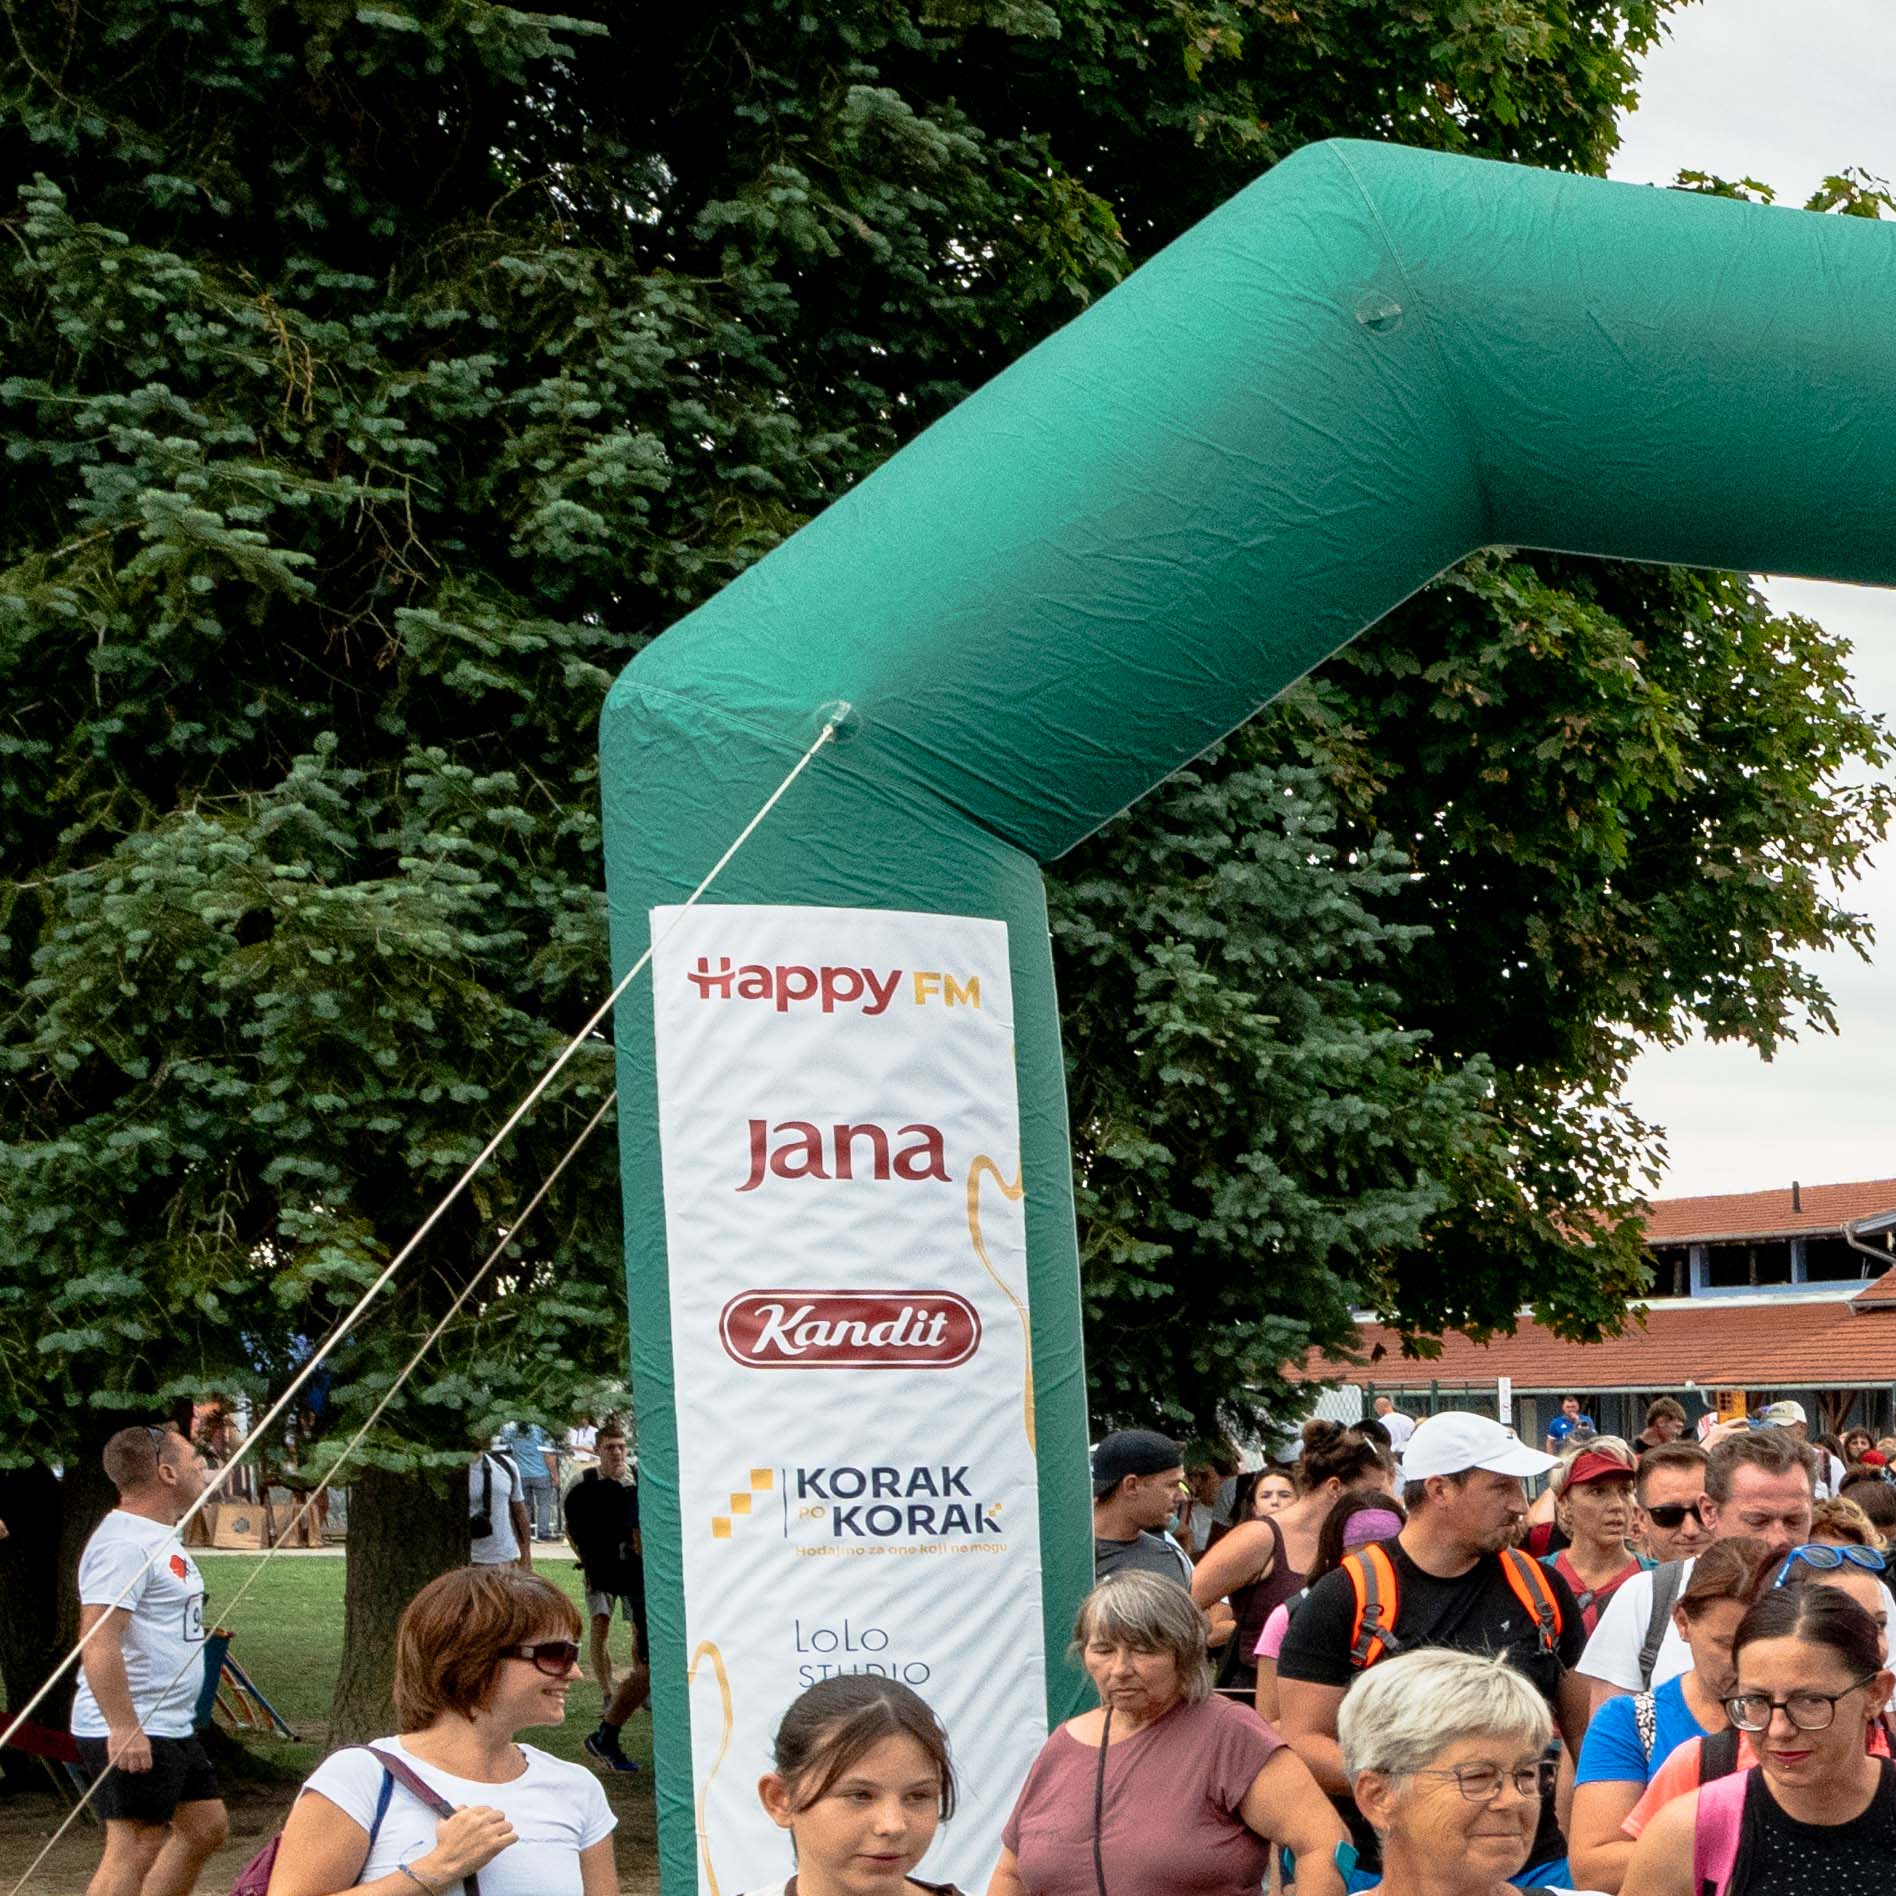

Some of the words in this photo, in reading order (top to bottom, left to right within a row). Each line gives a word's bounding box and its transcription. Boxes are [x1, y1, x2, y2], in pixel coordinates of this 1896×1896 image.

[687, 956, 903, 1016] Happy
[913, 971, 981, 1008] FM
[751, 1303, 949, 1355] Kandit
[797, 1466, 972, 1499] KORAK
[799, 1505, 826, 1520] PO
[833, 1503, 1002, 1537] KORAK
